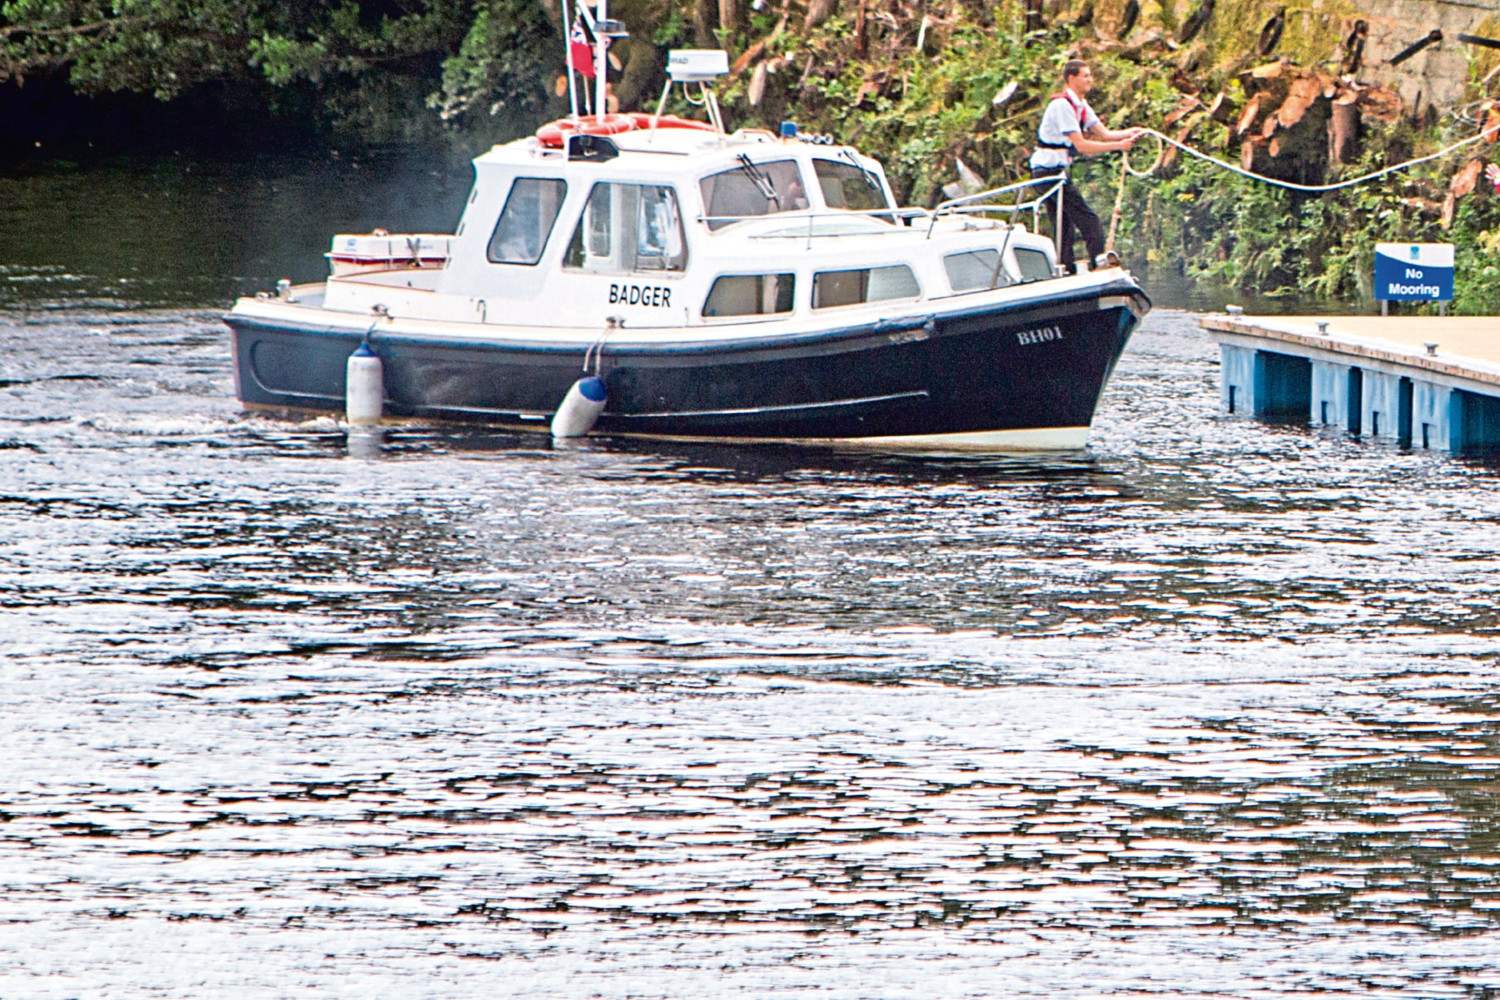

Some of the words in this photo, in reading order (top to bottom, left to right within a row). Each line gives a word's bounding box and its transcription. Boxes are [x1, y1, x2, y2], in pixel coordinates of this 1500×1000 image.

[1405, 268, 1423, 279] No
[609, 283, 671, 308] BADGER
[1388, 283, 1440, 298] Mooring
[1016, 325, 1064, 346] BH01
